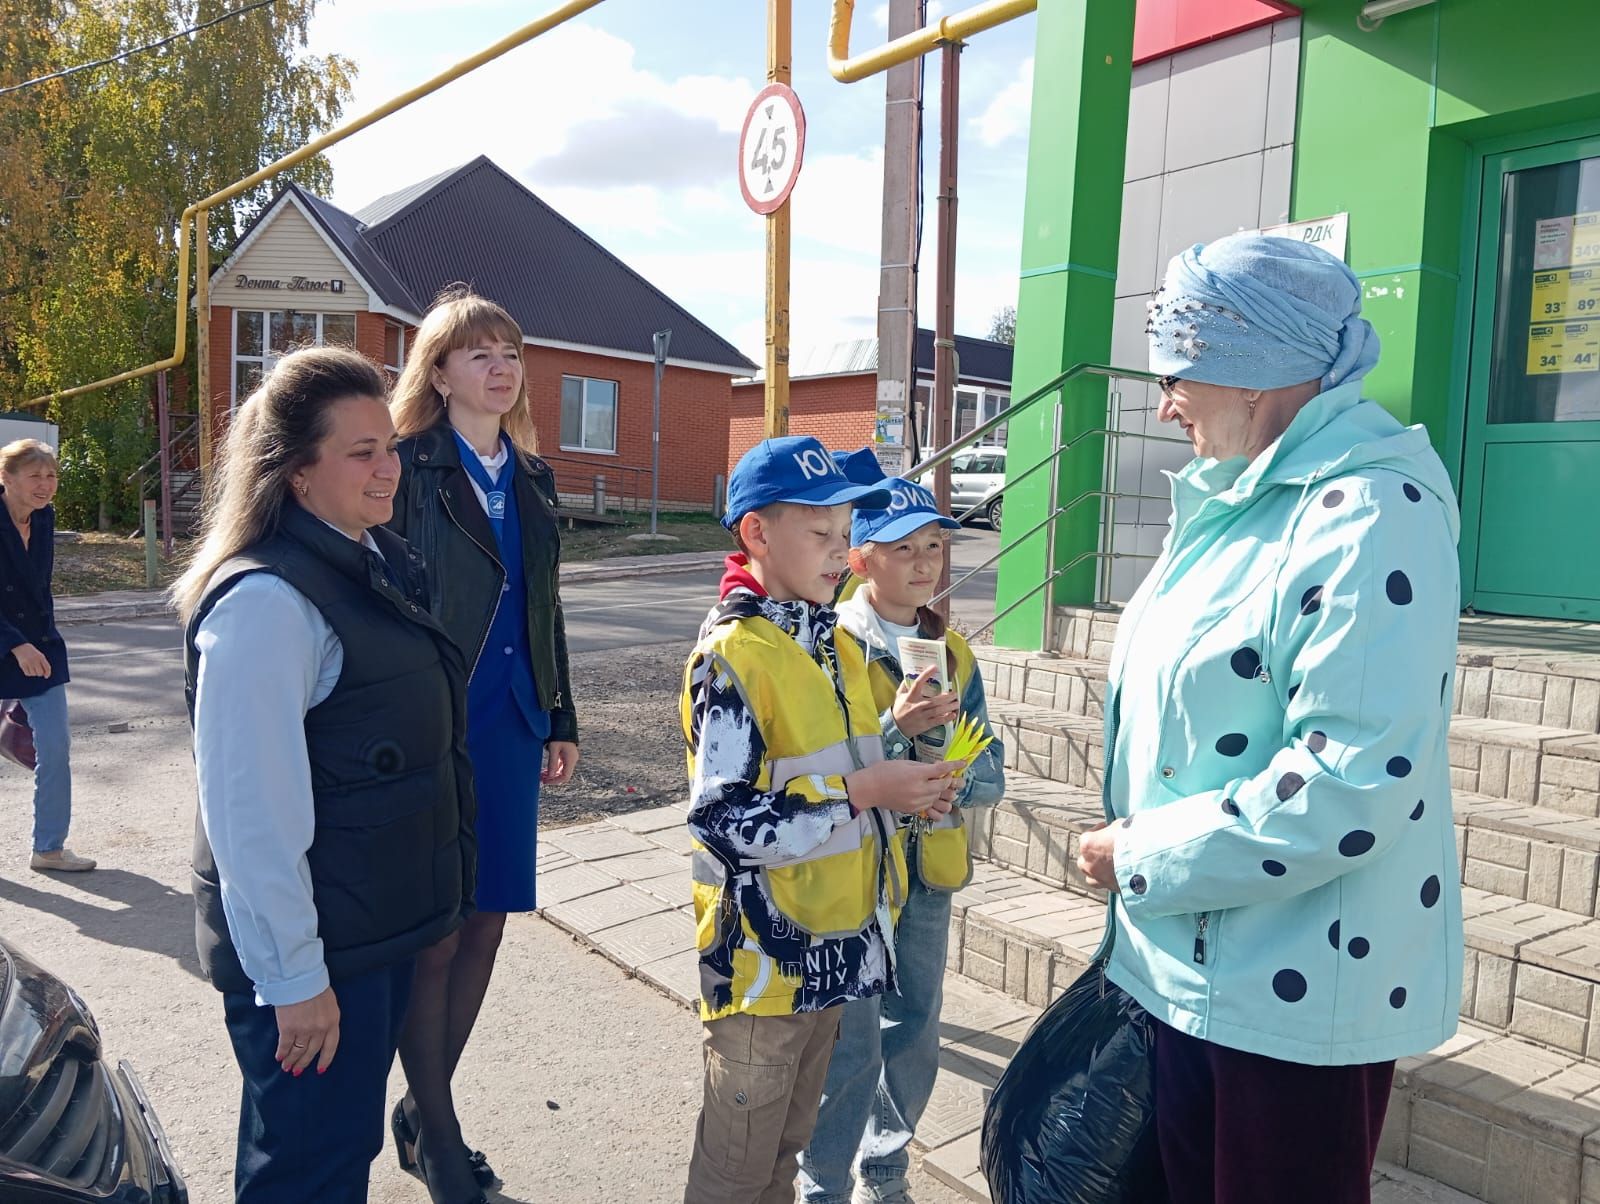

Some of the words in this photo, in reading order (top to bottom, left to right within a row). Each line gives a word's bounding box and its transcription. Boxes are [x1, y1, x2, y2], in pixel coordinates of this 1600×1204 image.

[1303, 224, 1335, 243] РДК
[235, 274, 280, 289] Дента
[287, 276, 328, 291] Плюс
[1544, 303, 1560, 313] 33
[1577, 299, 1595, 310] 89
[1540, 355, 1556, 366] 34
[1574, 353, 1591, 364] 44
